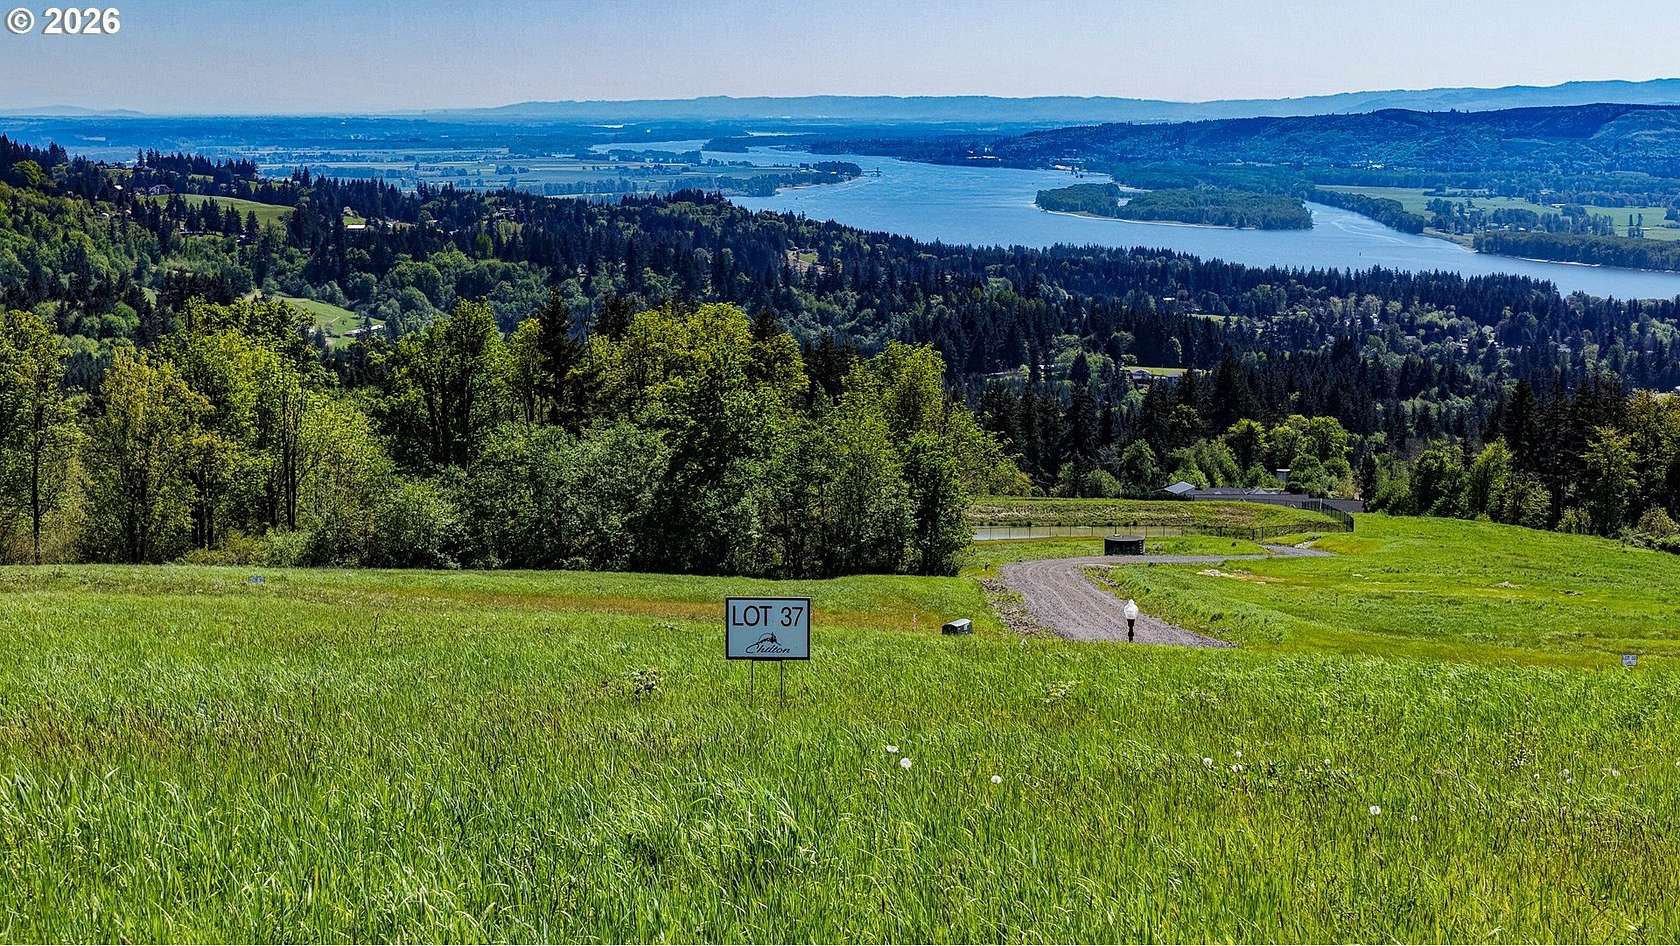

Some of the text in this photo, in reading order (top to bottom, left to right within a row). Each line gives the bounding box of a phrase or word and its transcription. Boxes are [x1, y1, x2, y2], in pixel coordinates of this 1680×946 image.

[732, 605, 804, 627] LOT 37
[745, 642, 791, 654] Chilton
